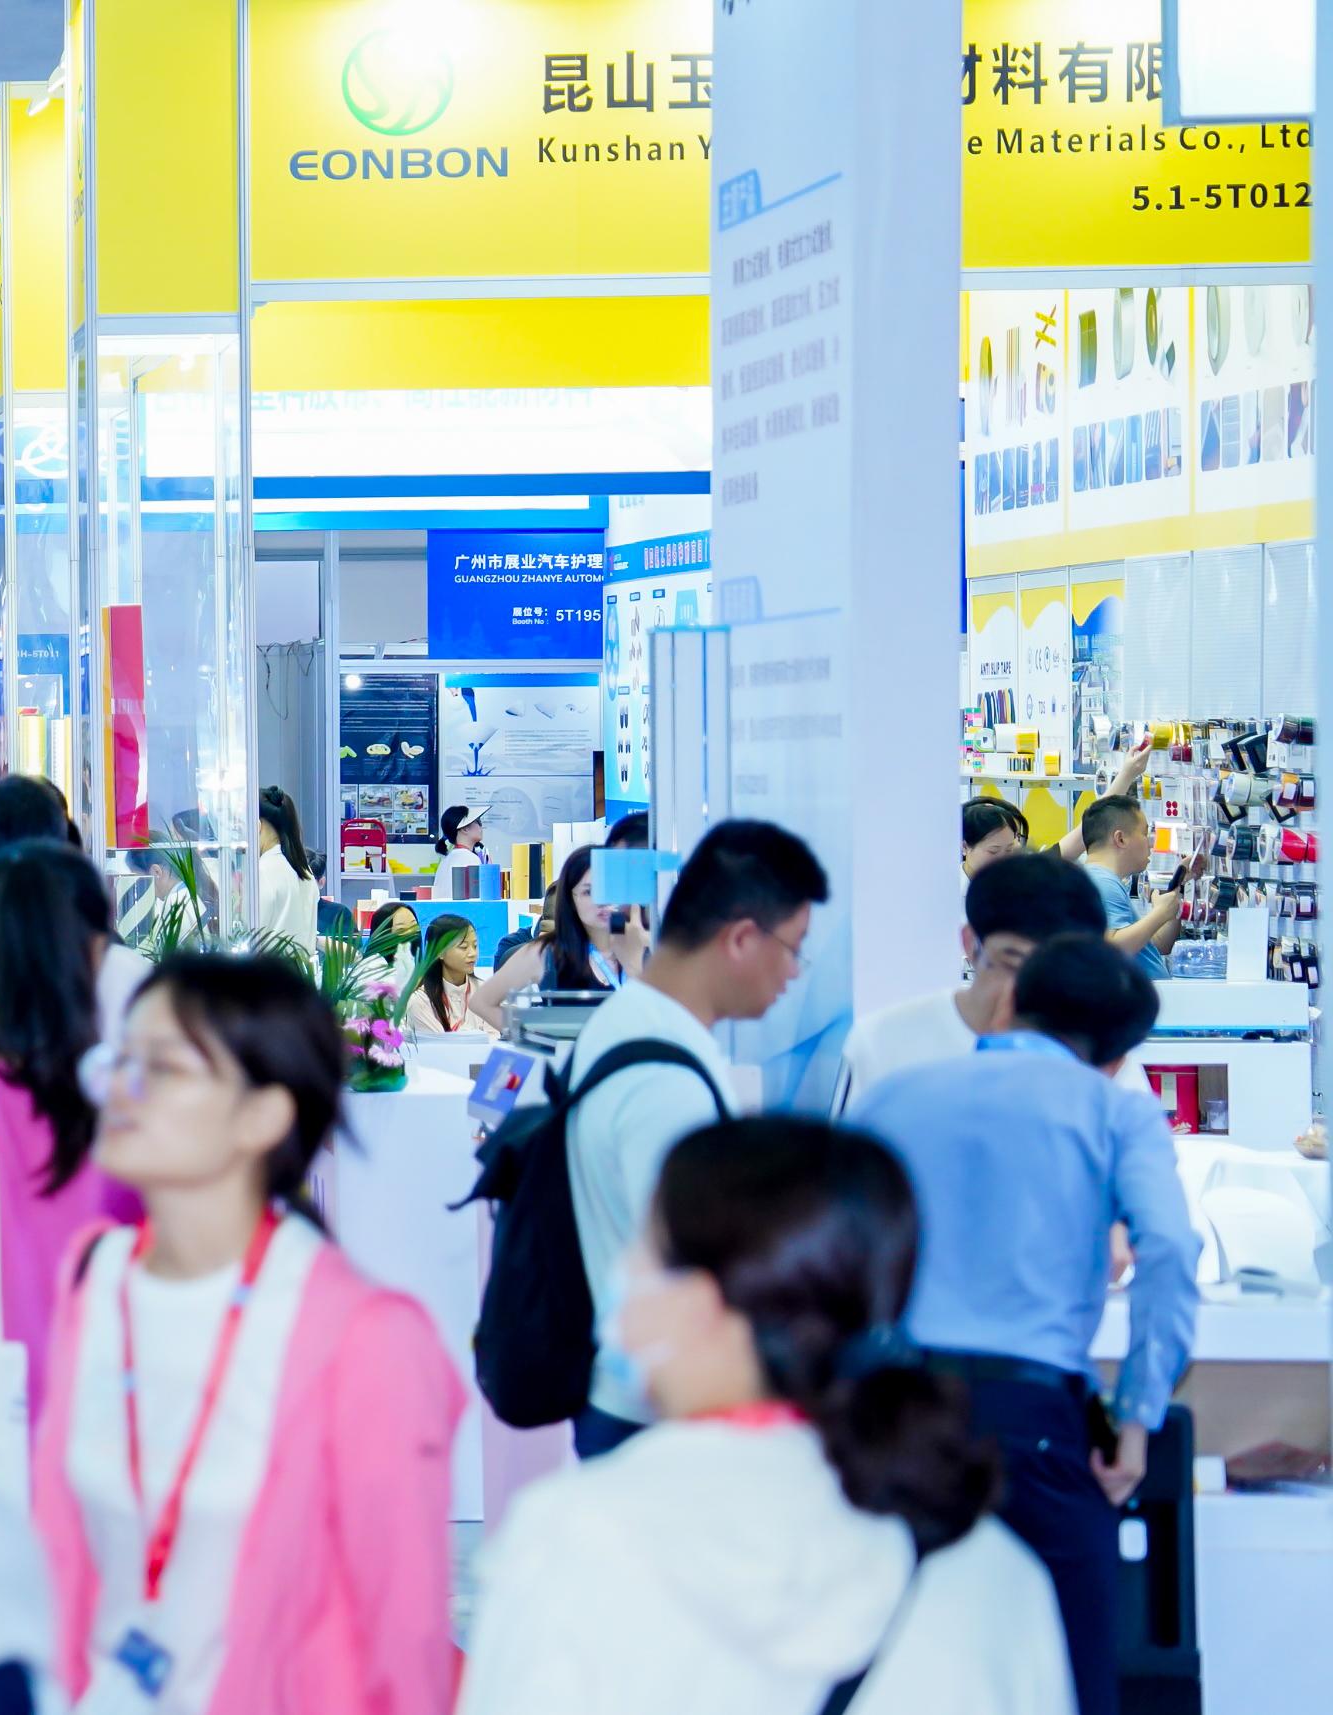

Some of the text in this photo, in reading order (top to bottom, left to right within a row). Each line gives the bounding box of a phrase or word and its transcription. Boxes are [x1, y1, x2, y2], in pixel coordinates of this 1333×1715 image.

[538, 134, 685, 163] Kunshan
[996, 124, 1166, 154] Materials
[1179, 126, 1246, 153] Co.,
[289, 146, 509, 181] EONBON
[1132, 181, 1313, 211] 5.1-5T012
[454, 553, 604, 570] 广州市展业汽车护理
[454, 574, 604, 583] GUANGZHOU ZHANYE AUTOM
[555, 609, 602, 622] 5T195
